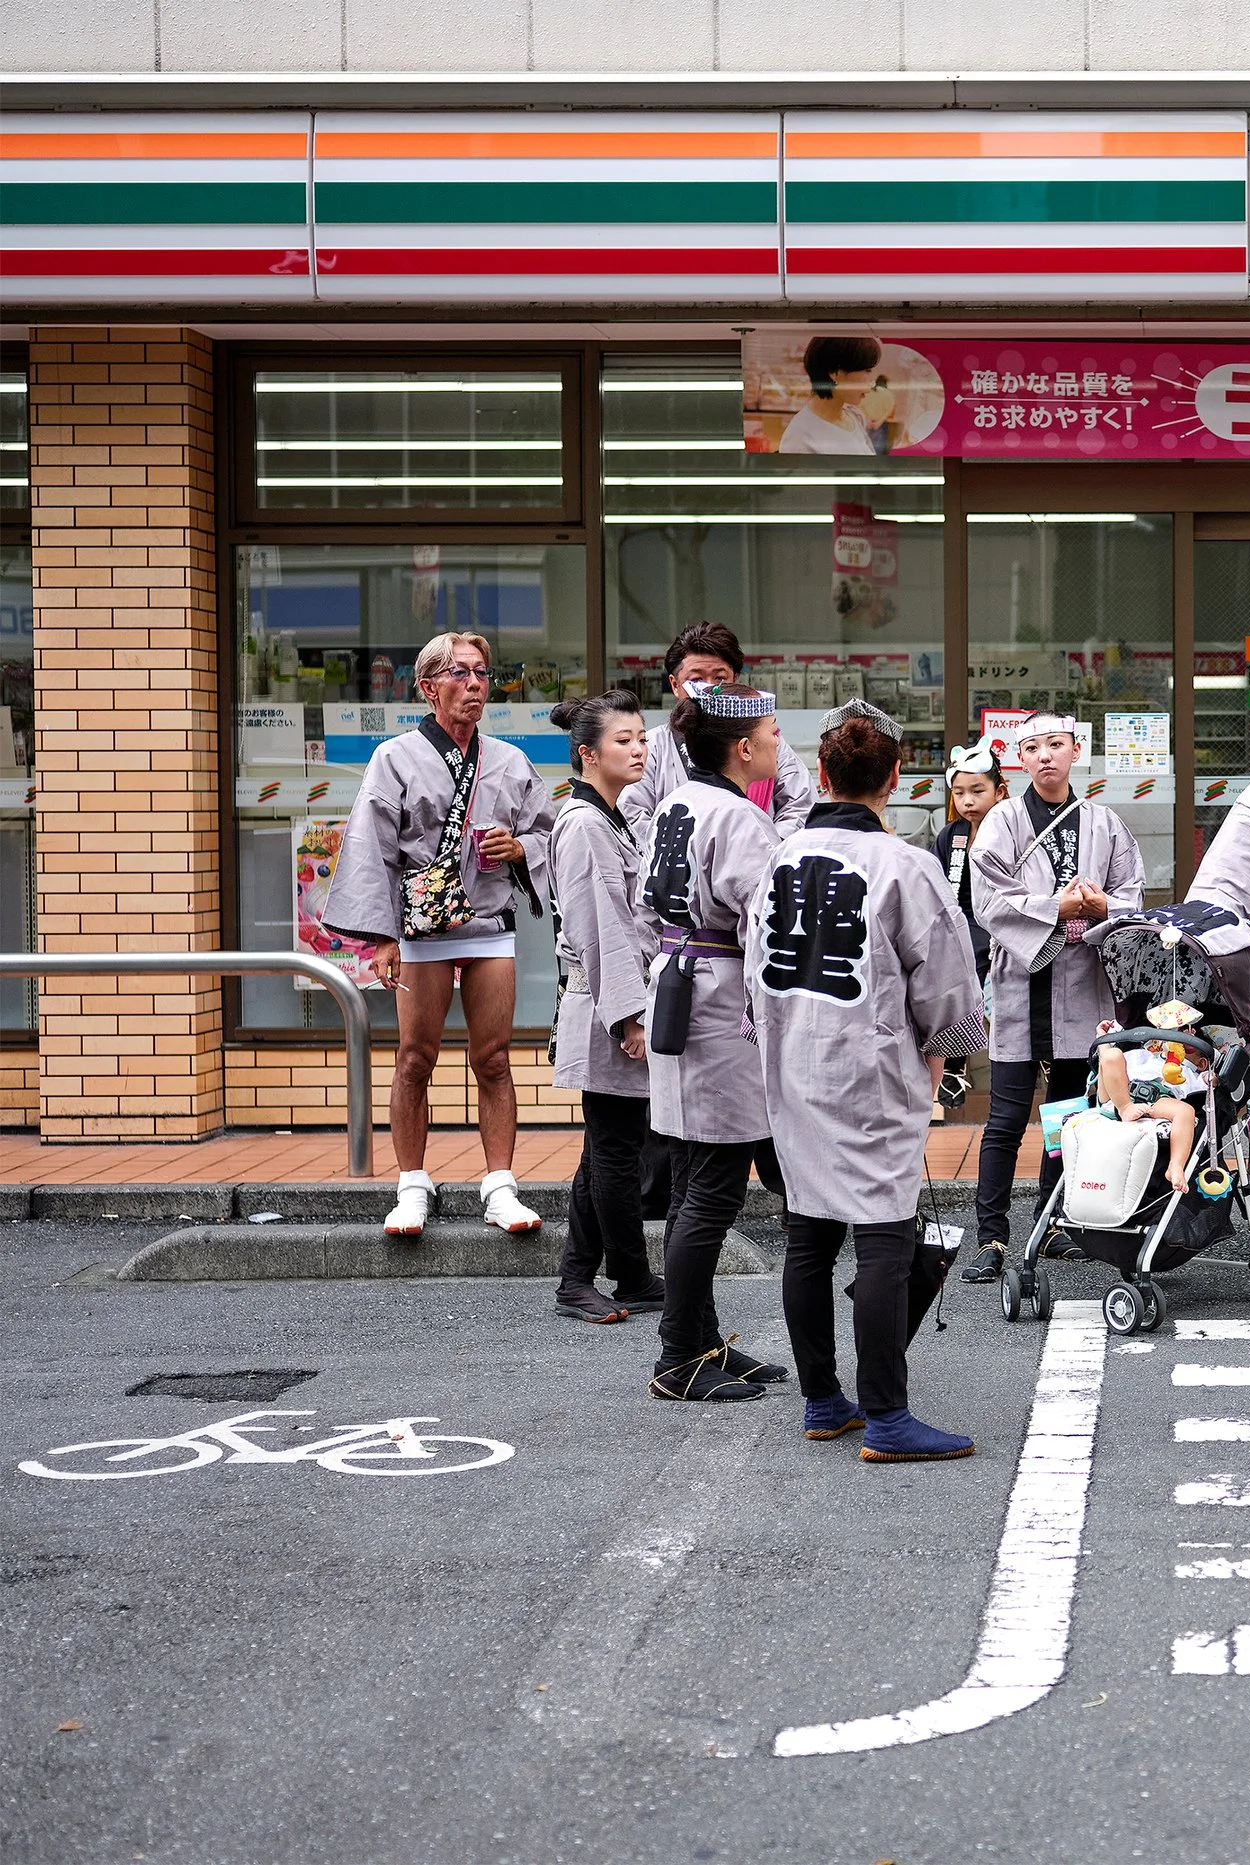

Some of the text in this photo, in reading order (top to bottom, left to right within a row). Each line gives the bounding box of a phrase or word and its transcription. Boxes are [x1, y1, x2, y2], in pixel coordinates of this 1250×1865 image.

[970, 369, 1134, 398] 確かな品質を
[972, 404, 1133, 432] お求めやすく!
[987, 719, 1025, 729] TAX-FR
